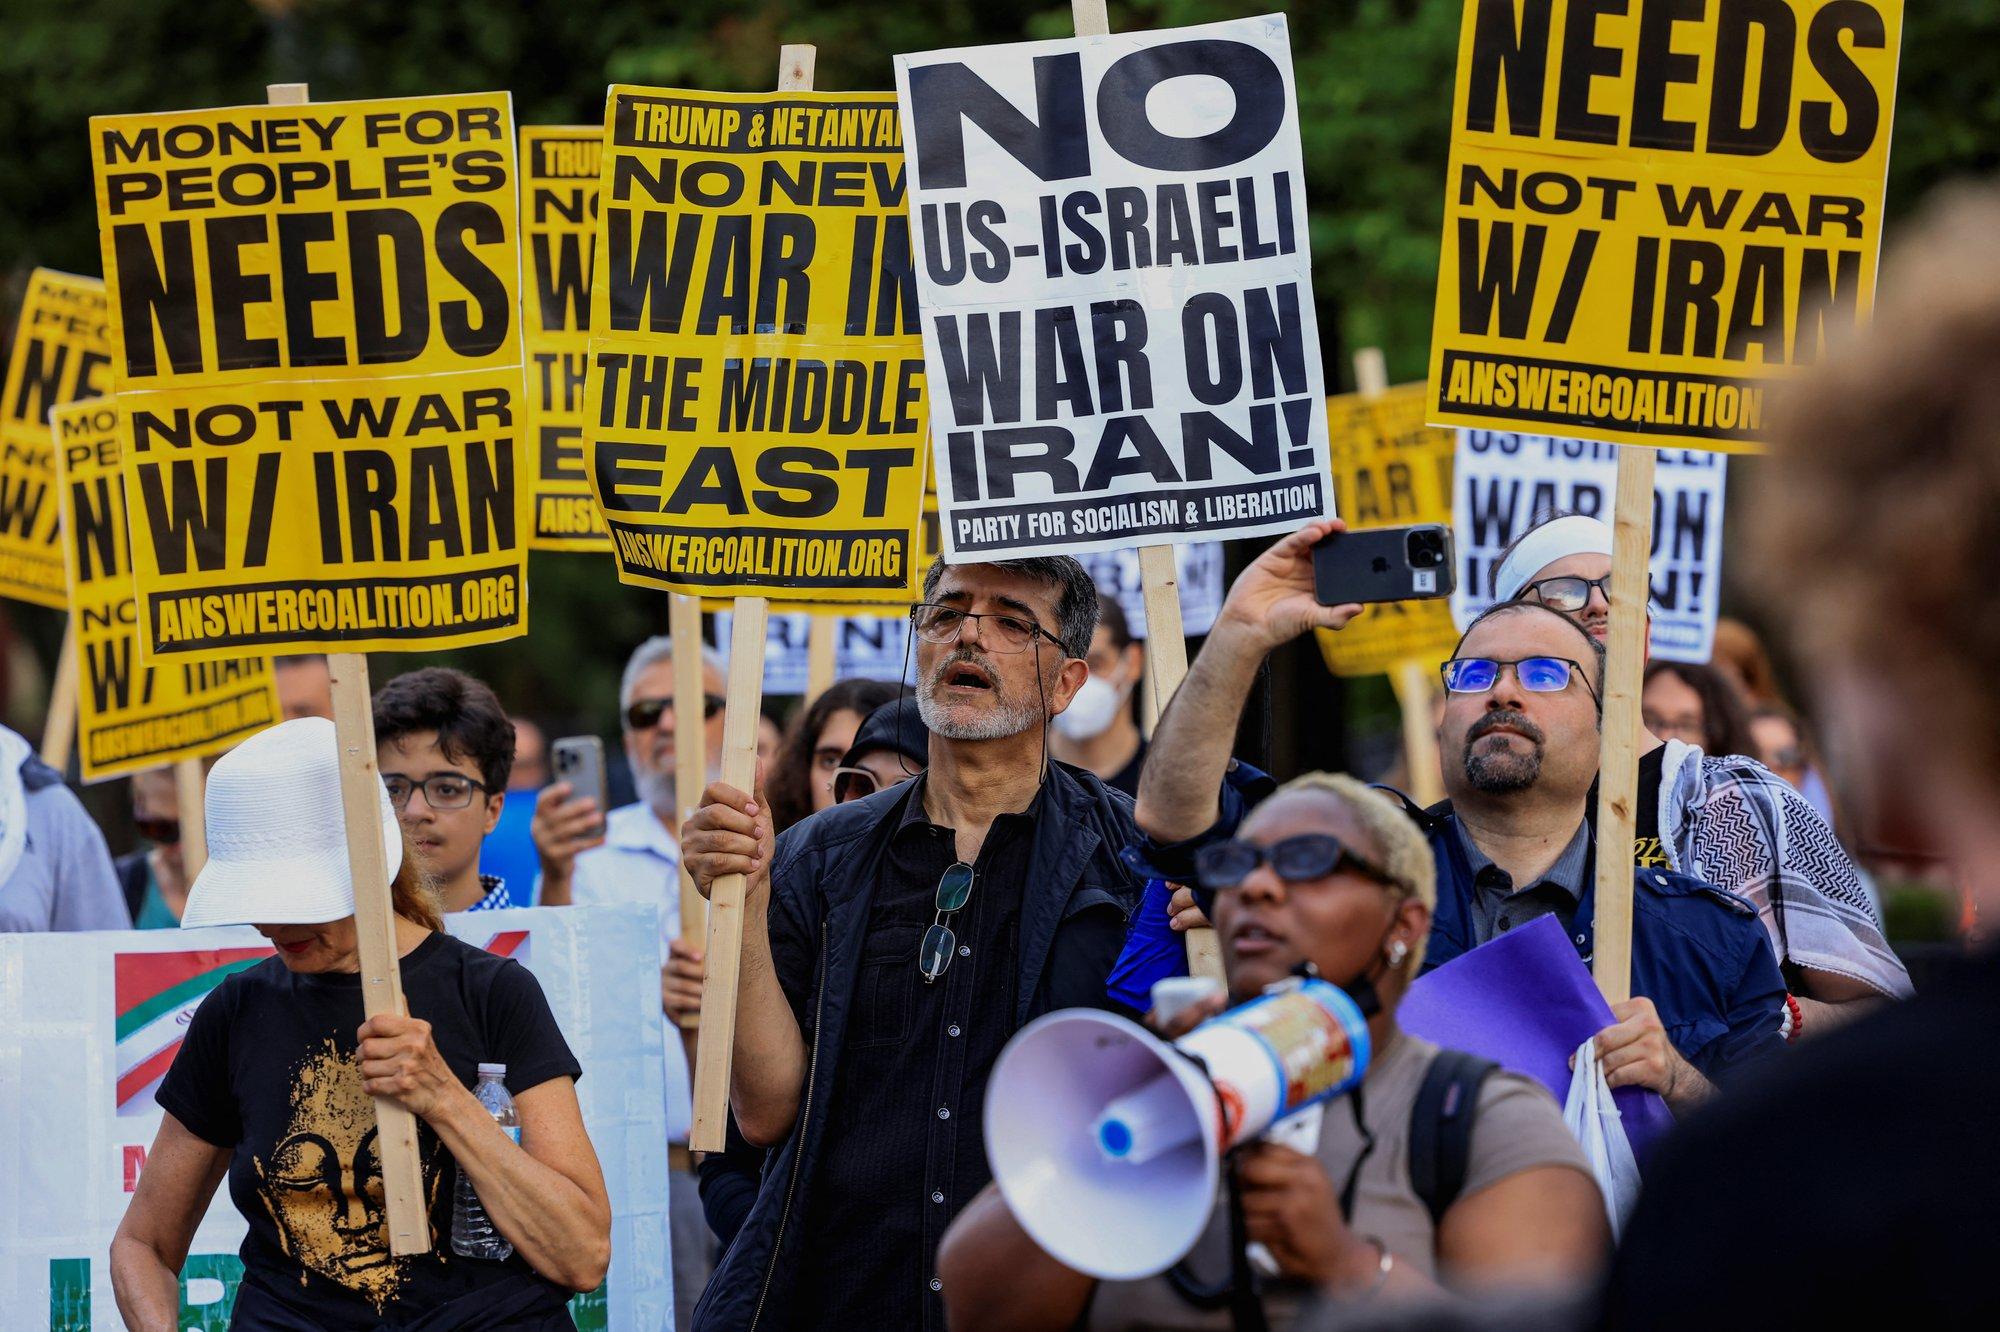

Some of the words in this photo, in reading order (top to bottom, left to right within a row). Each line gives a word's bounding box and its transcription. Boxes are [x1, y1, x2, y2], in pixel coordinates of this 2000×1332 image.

[908, 39, 1286, 190] NO
[1466, 0, 1886, 163] NEEDS
[102, 116, 347, 166] MONEY
[364, 107, 501, 148] FOR
[633, 103, 741, 147] TRUMP
[747, 113, 766, 147] &
[107, 150, 507, 216] PEOPLE'S
[535, 189, 599, 223] N
[612, 155, 745, 207] NO
[1459, 163, 1637, 221] NOT
[1655, 182, 1866, 240] WAR
[920, 171, 1296, 287] US-ISRAELI
[113, 201, 510, 378] NEEDS
[607, 208, 817, 336] WAR
[1457, 217, 1600, 344] W/
[1628, 236, 1862, 366] IRAN
[933, 298, 1154, 427] WAR
[1181, 282, 1308, 406] ON
[132, 401, 303, 452] NOT
[322, 388, 512, 439] WAR
[597, 353, 702, 433] THE
[717, 357, 926, 435] MIDDLE
[594, 441, 915, 519] EAST
[947, 397, 1315, 503] IRAN!
[137, 452, 281, 576] W/
[313, 437, 516, 565] IRAN
[958, 514, 1020, 545] PARTY
[1028, 510, 1066, 538] FOR
[1072, 500, 1179, 535] SOCIALISM
[1184, 501, 1199, 523] &
[1205, 484, 1316, 522] LIBERATION
[615, 528, 901, 578] ANSWERCOALITION.ORG
[159, 574, 515, 643] ANSWERCOALITION.ORG
